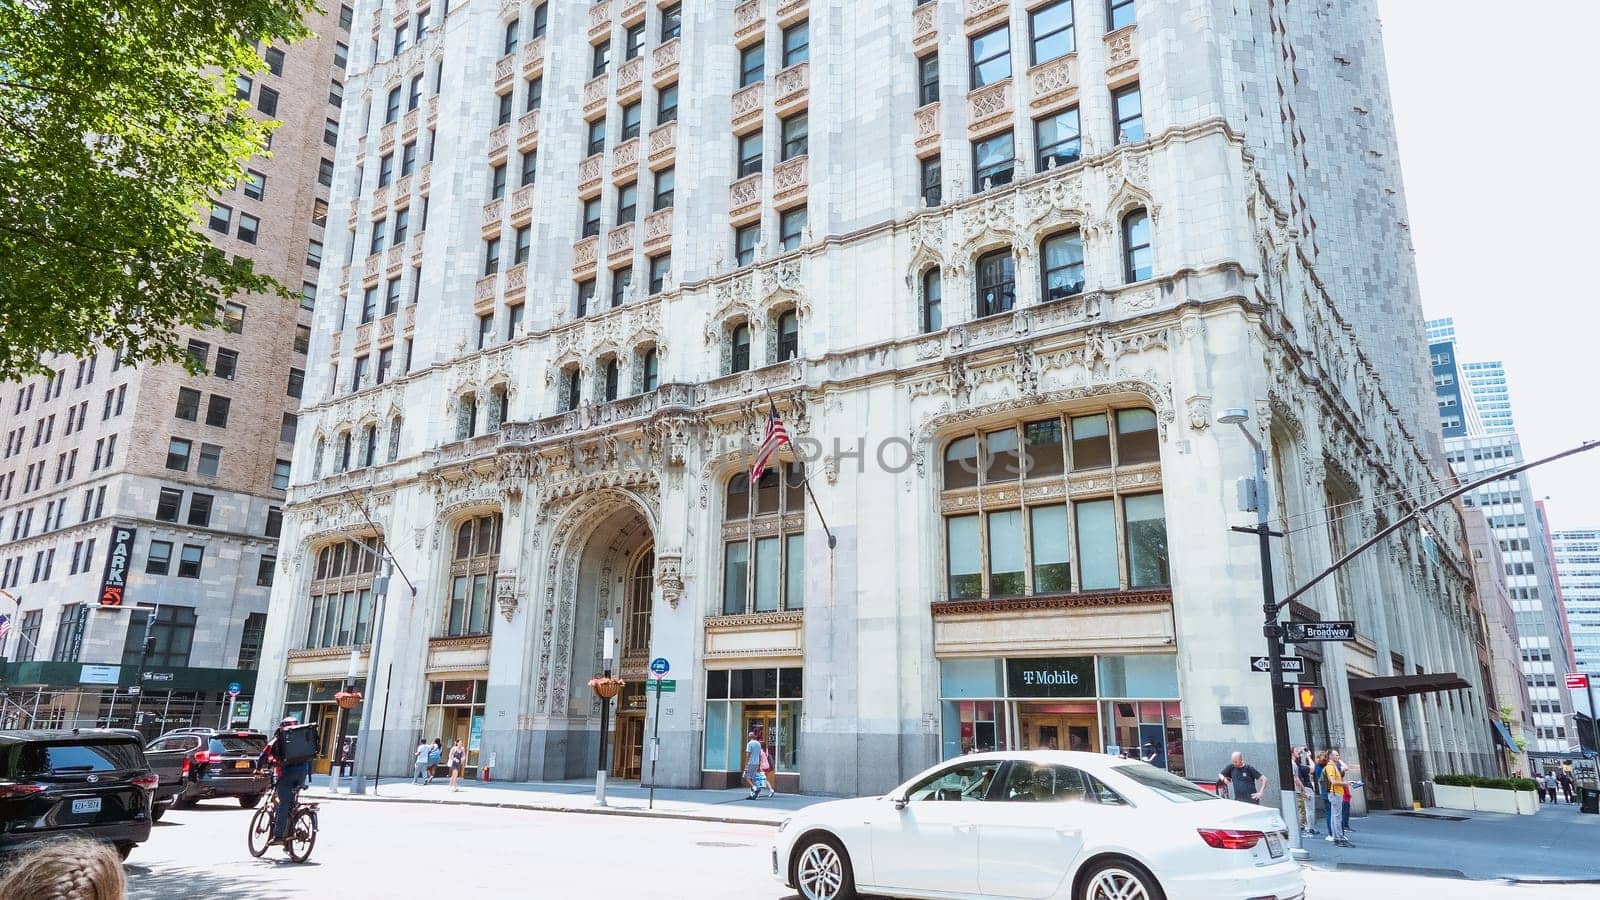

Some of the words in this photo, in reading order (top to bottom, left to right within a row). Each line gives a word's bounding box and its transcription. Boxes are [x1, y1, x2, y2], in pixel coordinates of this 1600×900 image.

[109, 530, 130, 582] PARK
[1307, 627, 1349, 638] Broadway
[1035, 670, 1079, 685] Mobile
